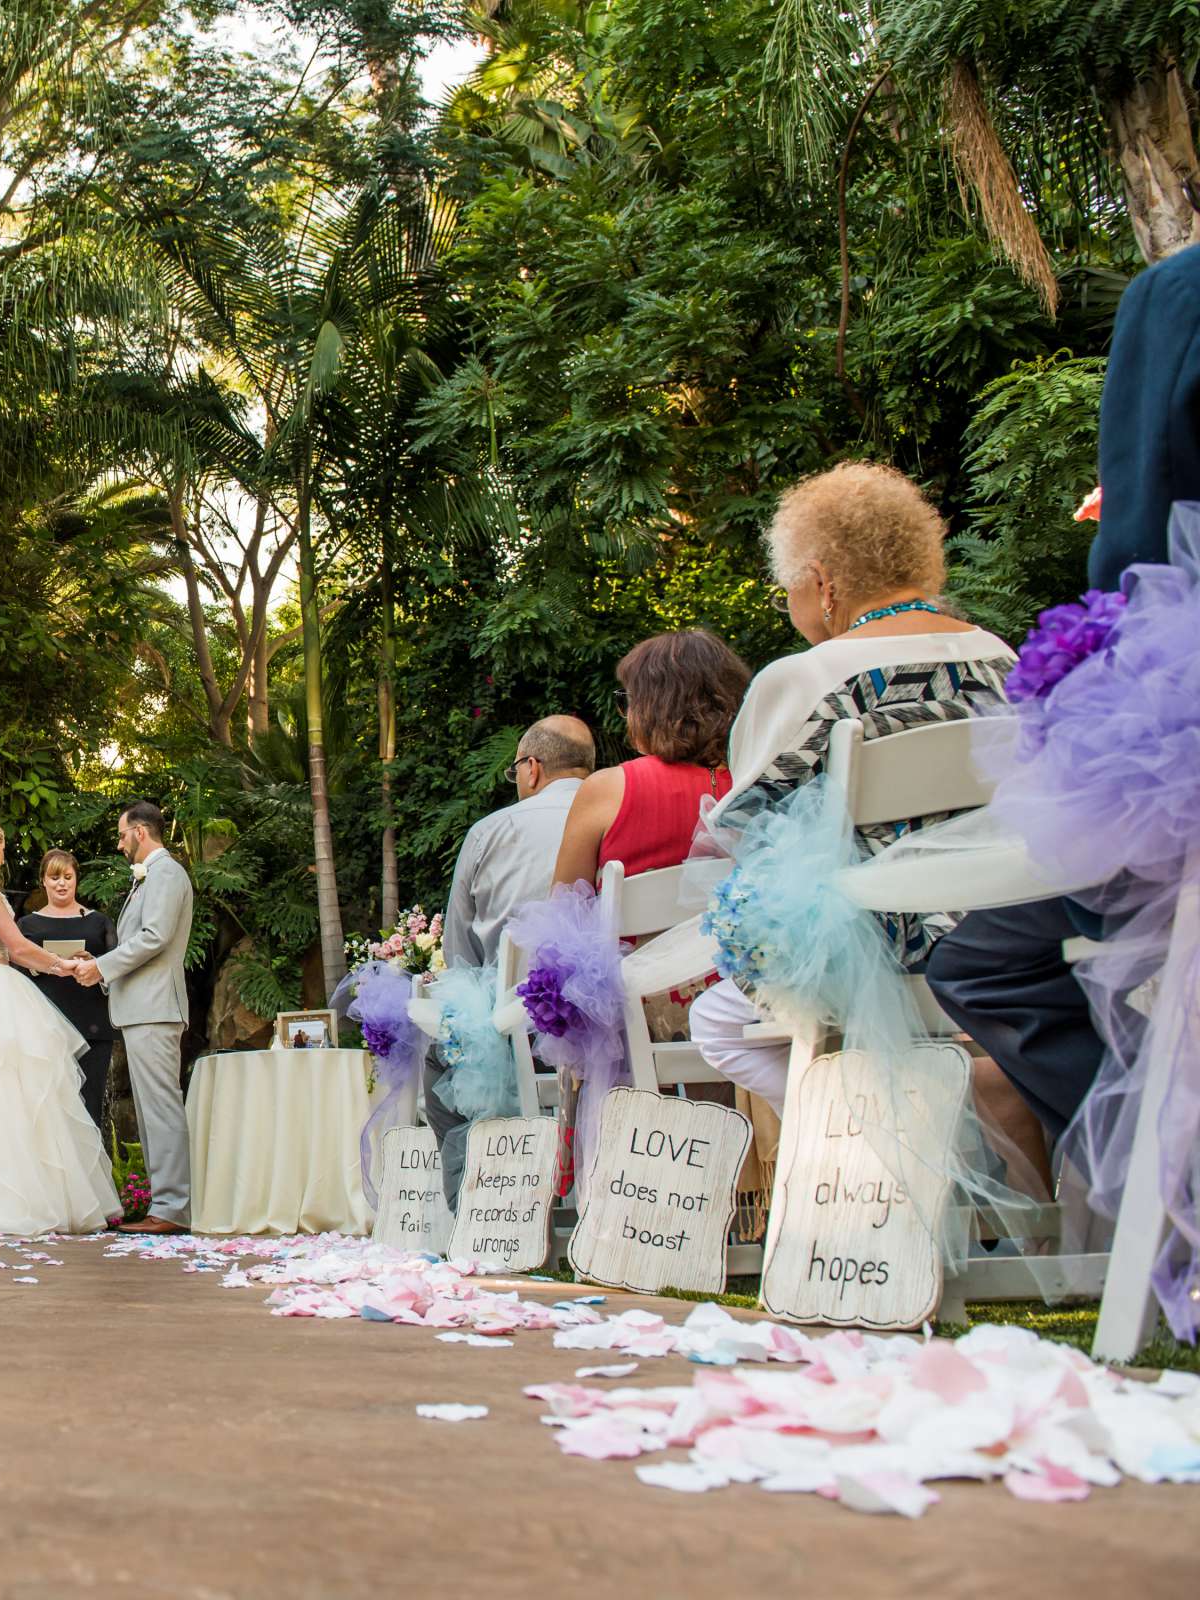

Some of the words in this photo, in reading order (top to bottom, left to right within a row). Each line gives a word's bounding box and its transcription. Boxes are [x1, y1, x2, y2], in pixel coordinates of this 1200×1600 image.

[486, 1133, 536, 1157] LOVE
[630, 1127, 711, 1169] LOVE
[400, 1149, 441, 1170] LOVE
[521, 1173, 540, 1188] no
[610, 1169, 657, 1203] does
[667, 1190, 708, 1213] not
[399, 1188, 441, 1202] never
[814, 1166, 907, 1229] always
[399, 1211, 432, 1234] fails
[469, 1201, 518, 1224] records
[521, 1201, 541, 1223] of
[622, 1216, 690, 1252] boast
[472, 1236, 520, 1262] wrongs
[808, 1240, 890, 1301] hopes
